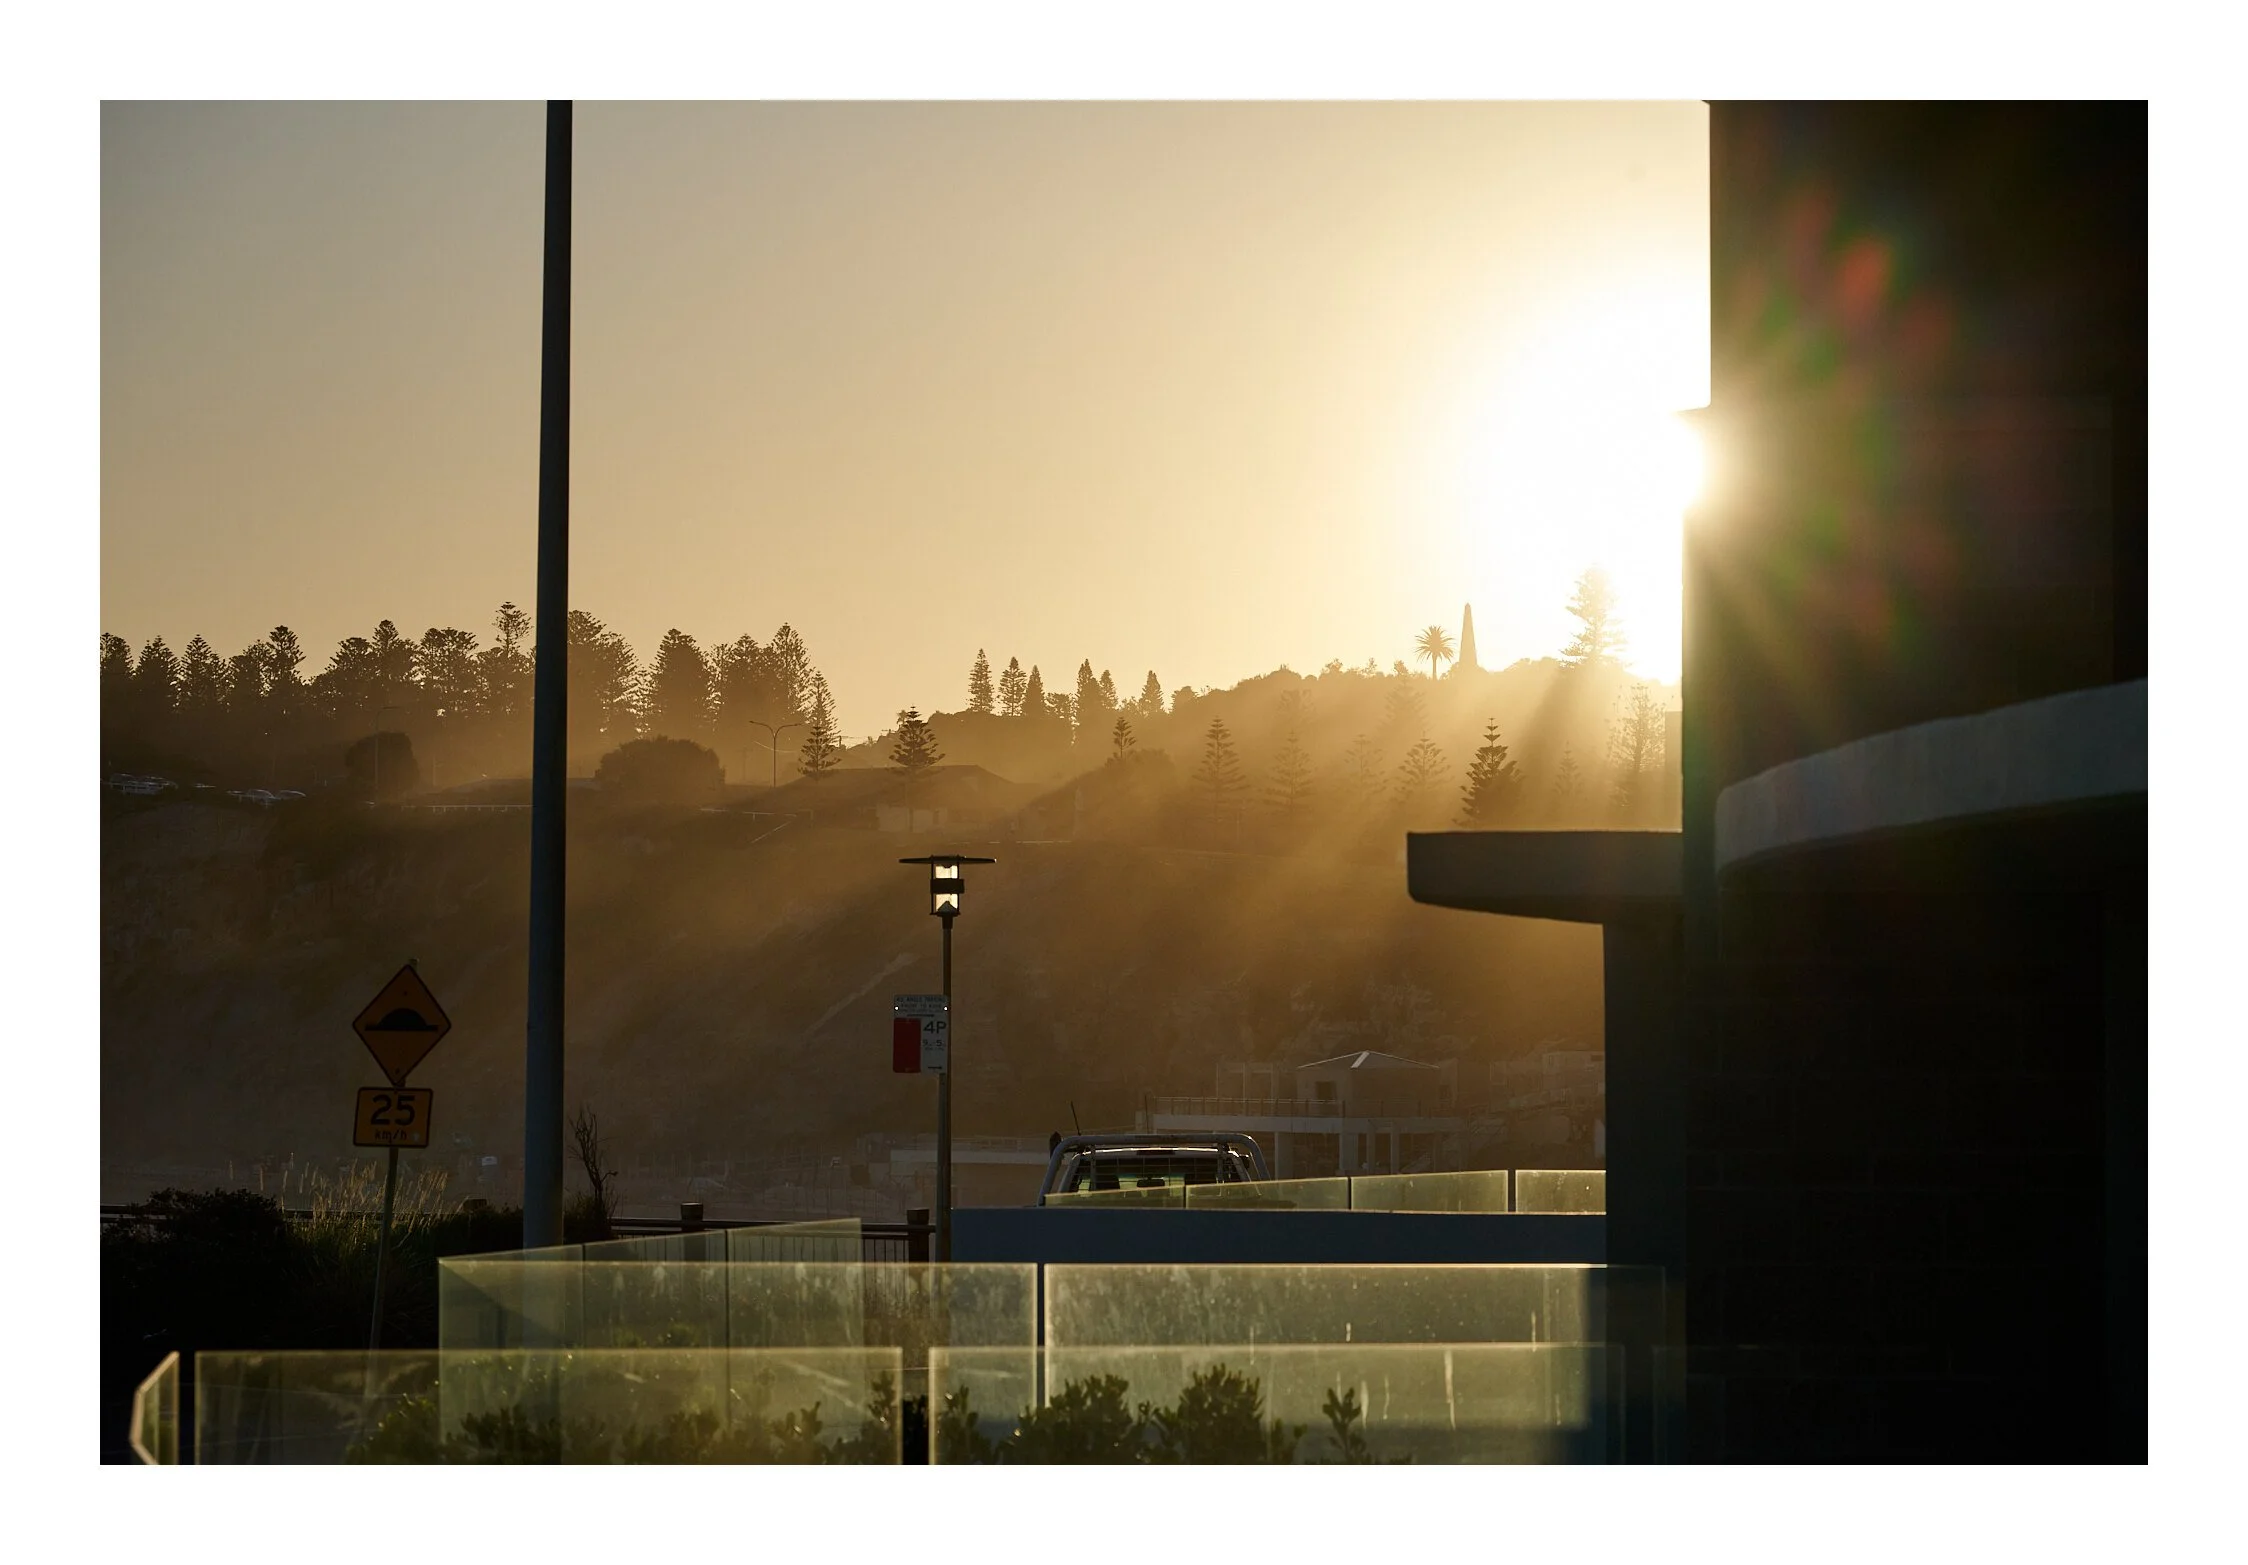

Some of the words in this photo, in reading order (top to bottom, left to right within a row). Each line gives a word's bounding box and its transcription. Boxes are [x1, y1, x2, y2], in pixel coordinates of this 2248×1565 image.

[923, 1020, 947, 1034] 4P
[371, 1094, 416, 1126] 25
[375, 1129, 407, 1140] km/h
